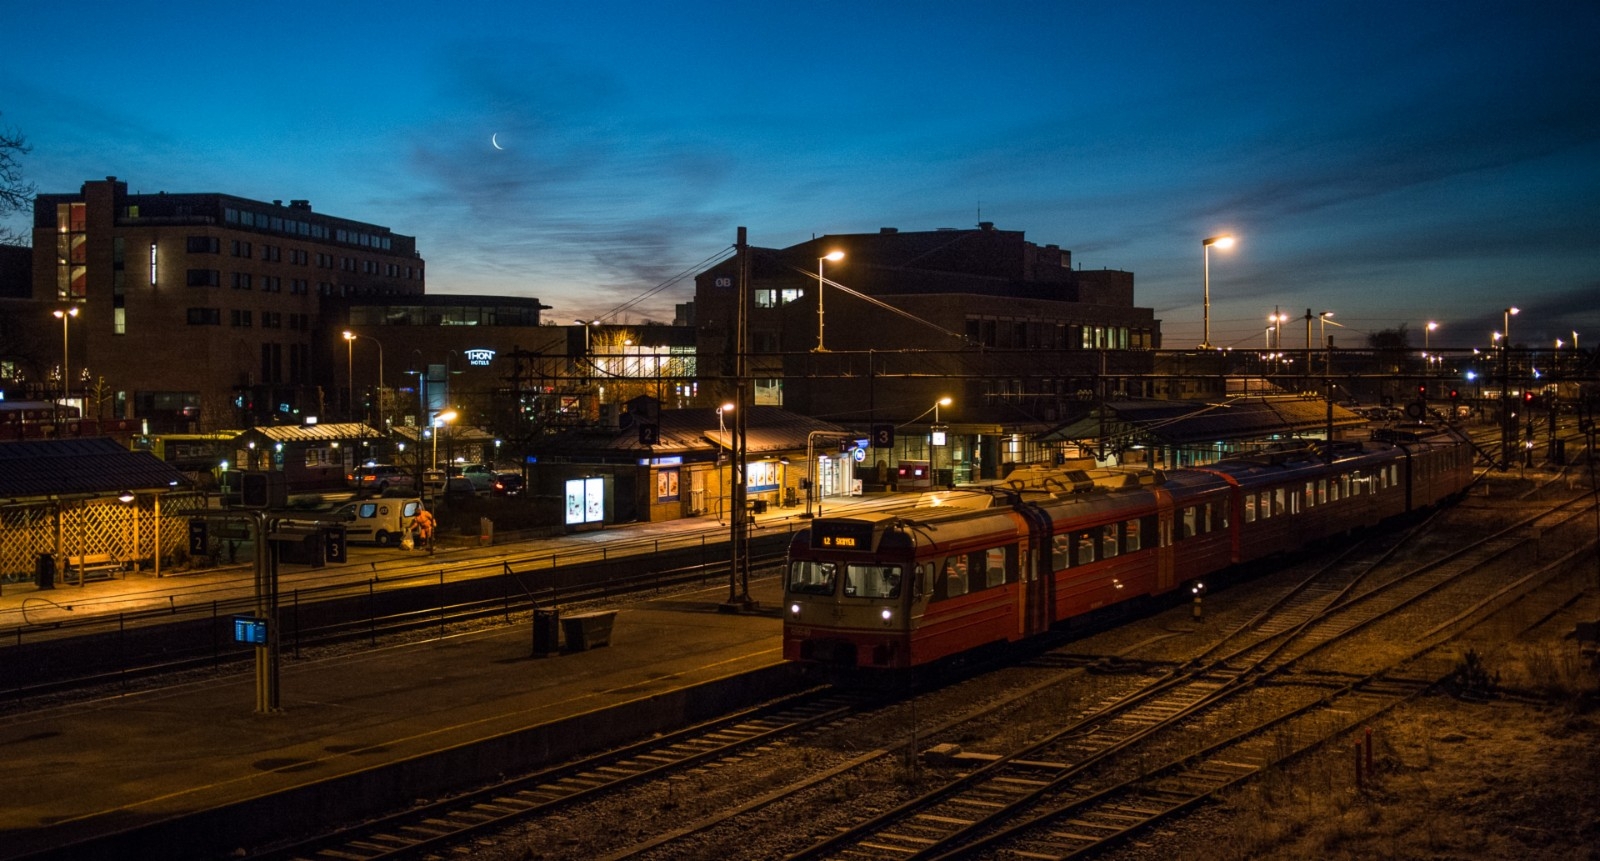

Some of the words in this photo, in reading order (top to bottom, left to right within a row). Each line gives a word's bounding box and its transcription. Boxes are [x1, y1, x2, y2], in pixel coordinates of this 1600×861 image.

[464, 349, 496, 360] THON
[644, 428, 652, 440] 2
[880, 430, 889, 443] 3
[195, 536, 202, 550] 2
[331, 543, 339, 557] 3
